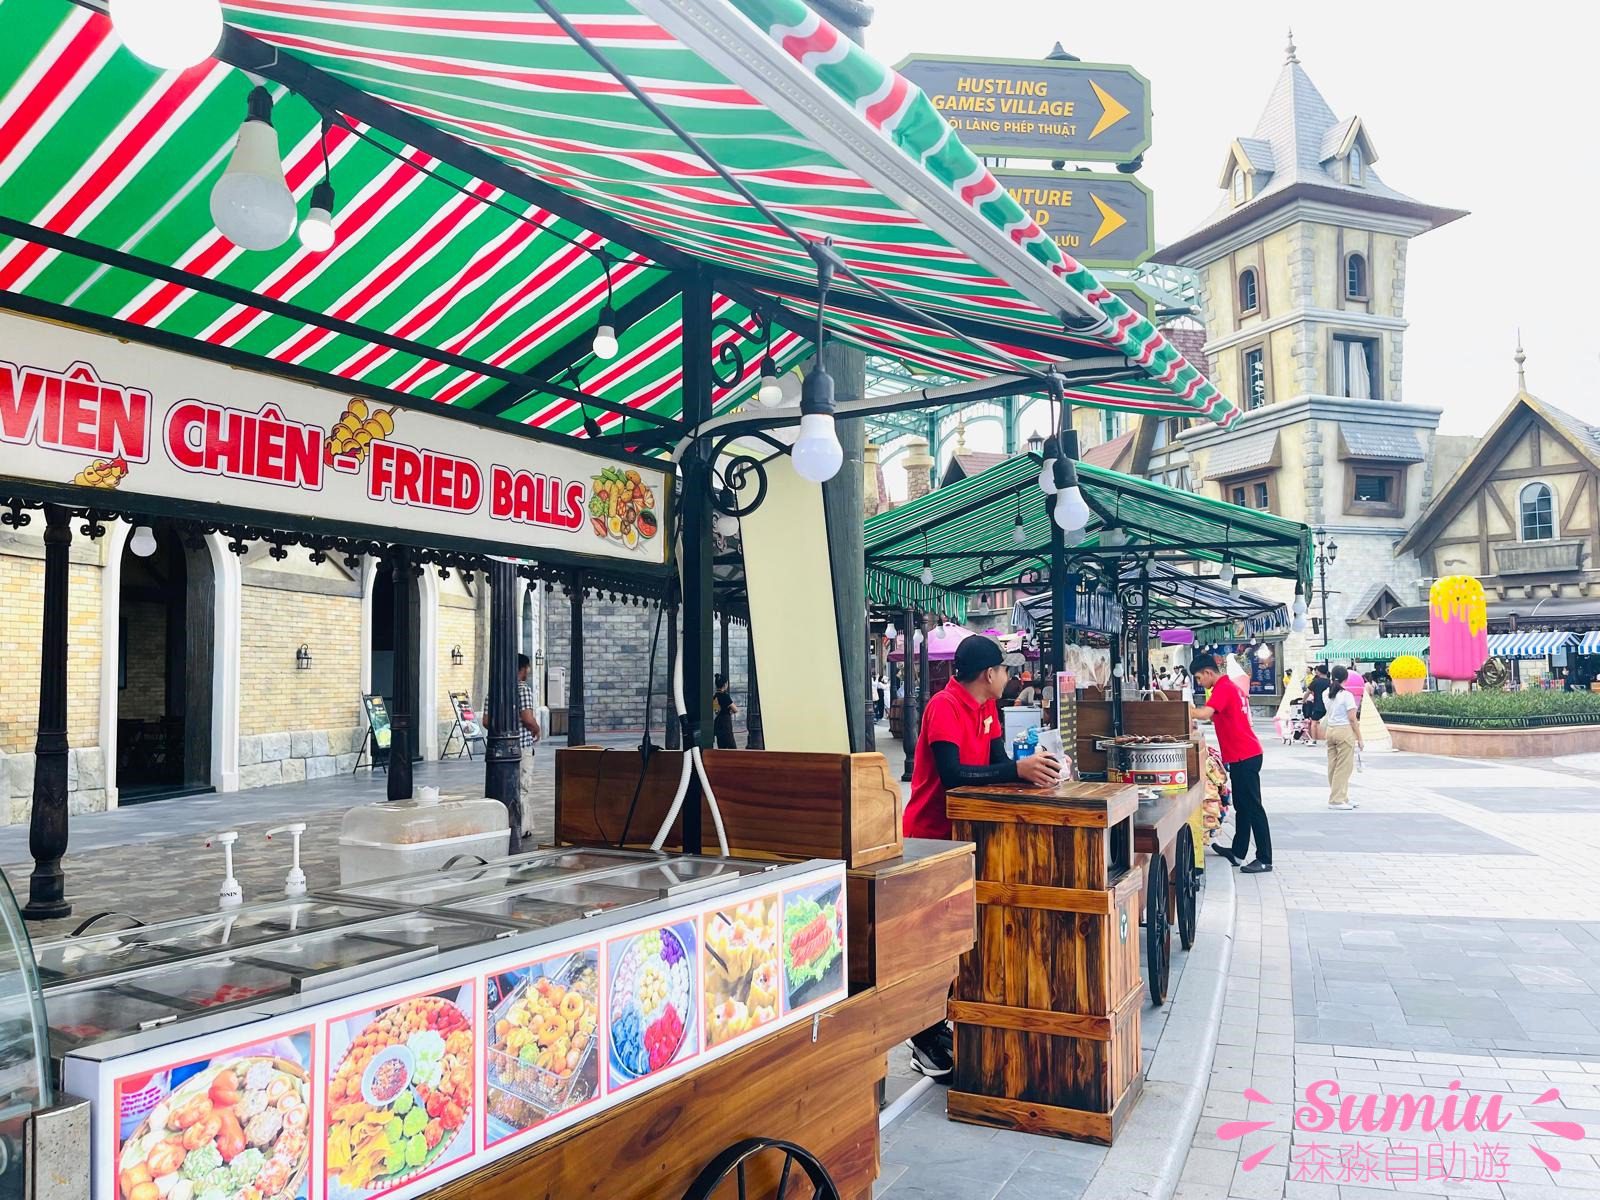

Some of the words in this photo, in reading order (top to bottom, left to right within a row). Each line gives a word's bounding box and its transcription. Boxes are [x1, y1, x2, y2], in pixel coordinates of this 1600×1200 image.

[957, 77, 1047, 96] HUSTLING
[931, 95, 996, 113] GAMES
[1000, 98, 1075, 117] VILLAGE
[965, 117, 1001, 133] LÀNG
[1004, 120, 1035, 134] PHÉP
[1038, 122, 1077, 138] THUẬT
[1007, 188, 1073, 207] NTURE
[0, 365, 149, 460] VIÊN
[167, 403, 323, 488] CHIÊN
[370, 442, 481, 511] FRIED
[492, 463, 585, 530] BALLS
